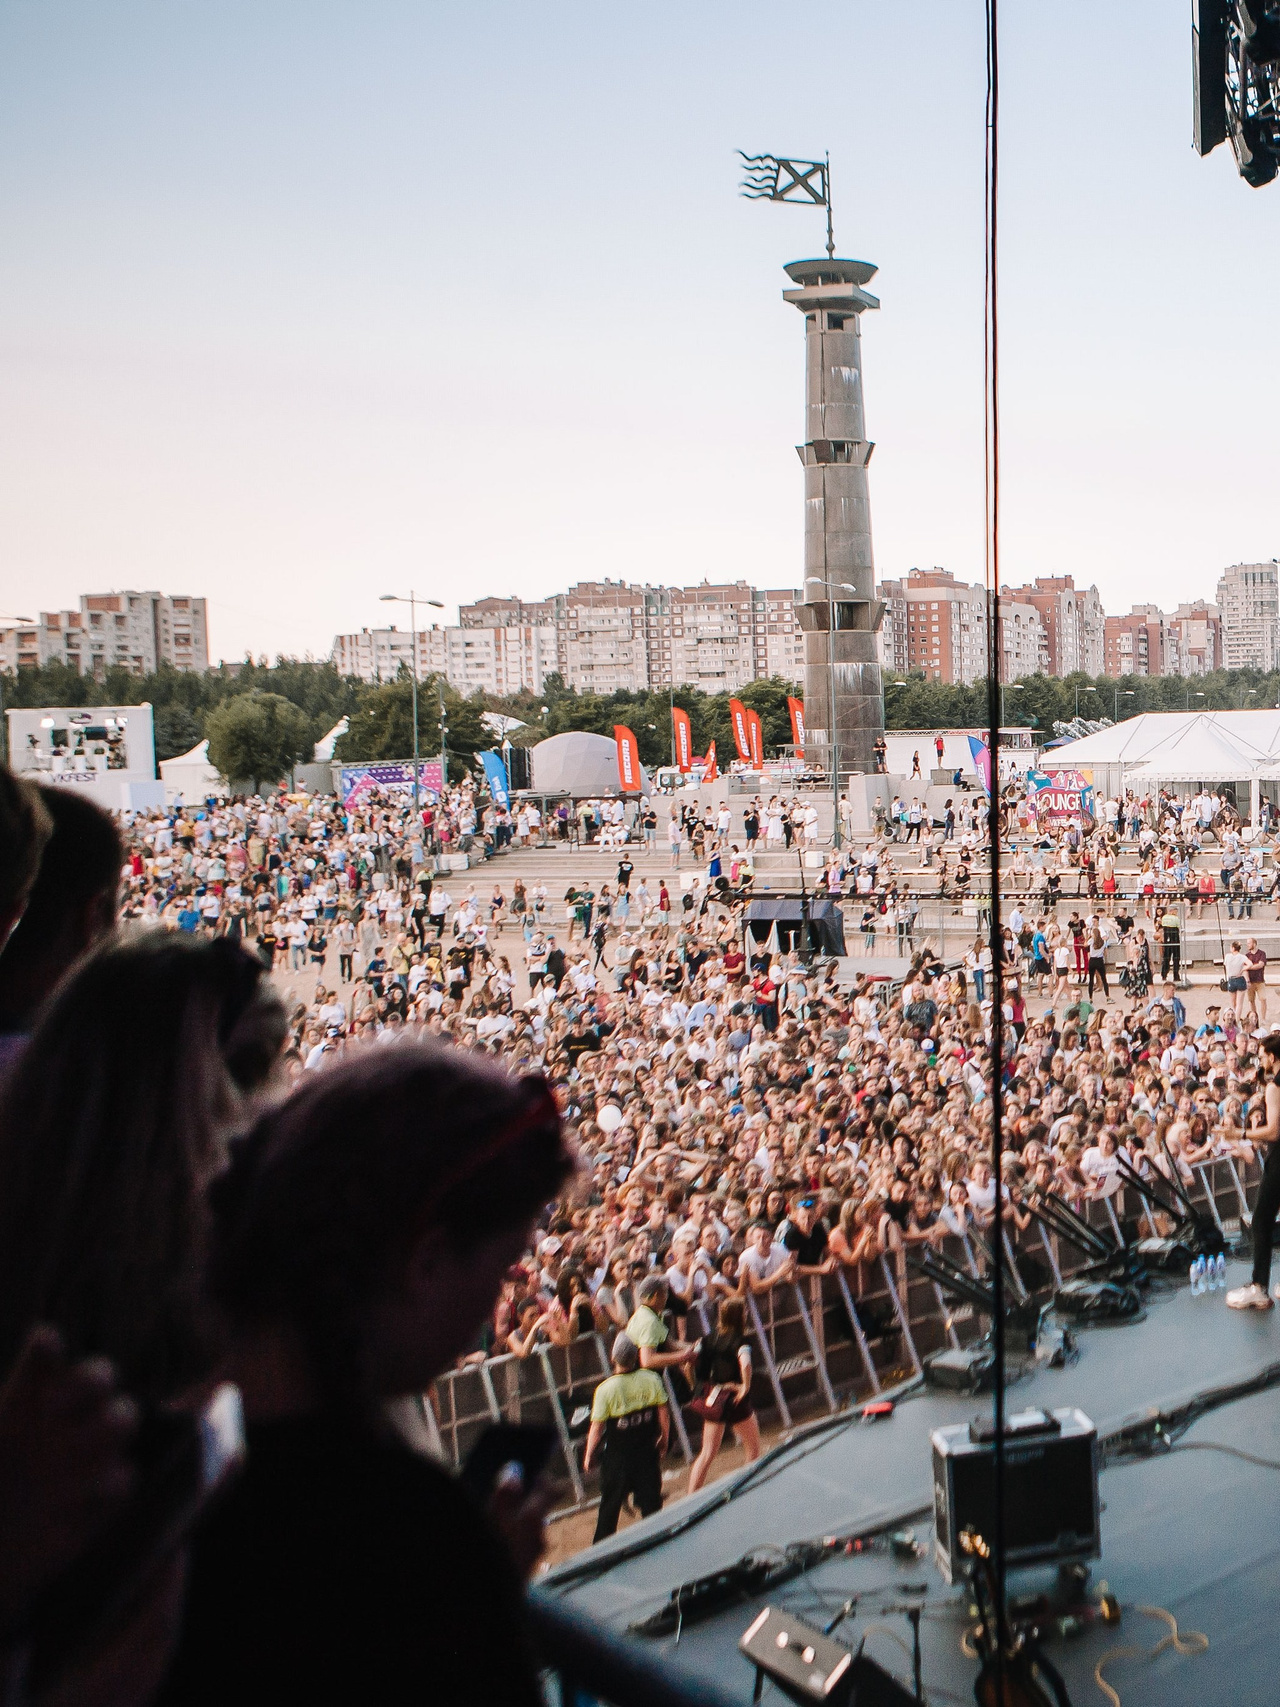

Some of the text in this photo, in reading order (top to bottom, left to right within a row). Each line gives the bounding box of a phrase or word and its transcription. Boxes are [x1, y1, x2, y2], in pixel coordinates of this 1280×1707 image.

[679, 722, 689, 766] RECORD
[736, 712, 750, 756] RECORD
[622, 739, 633, 784] RECORD
